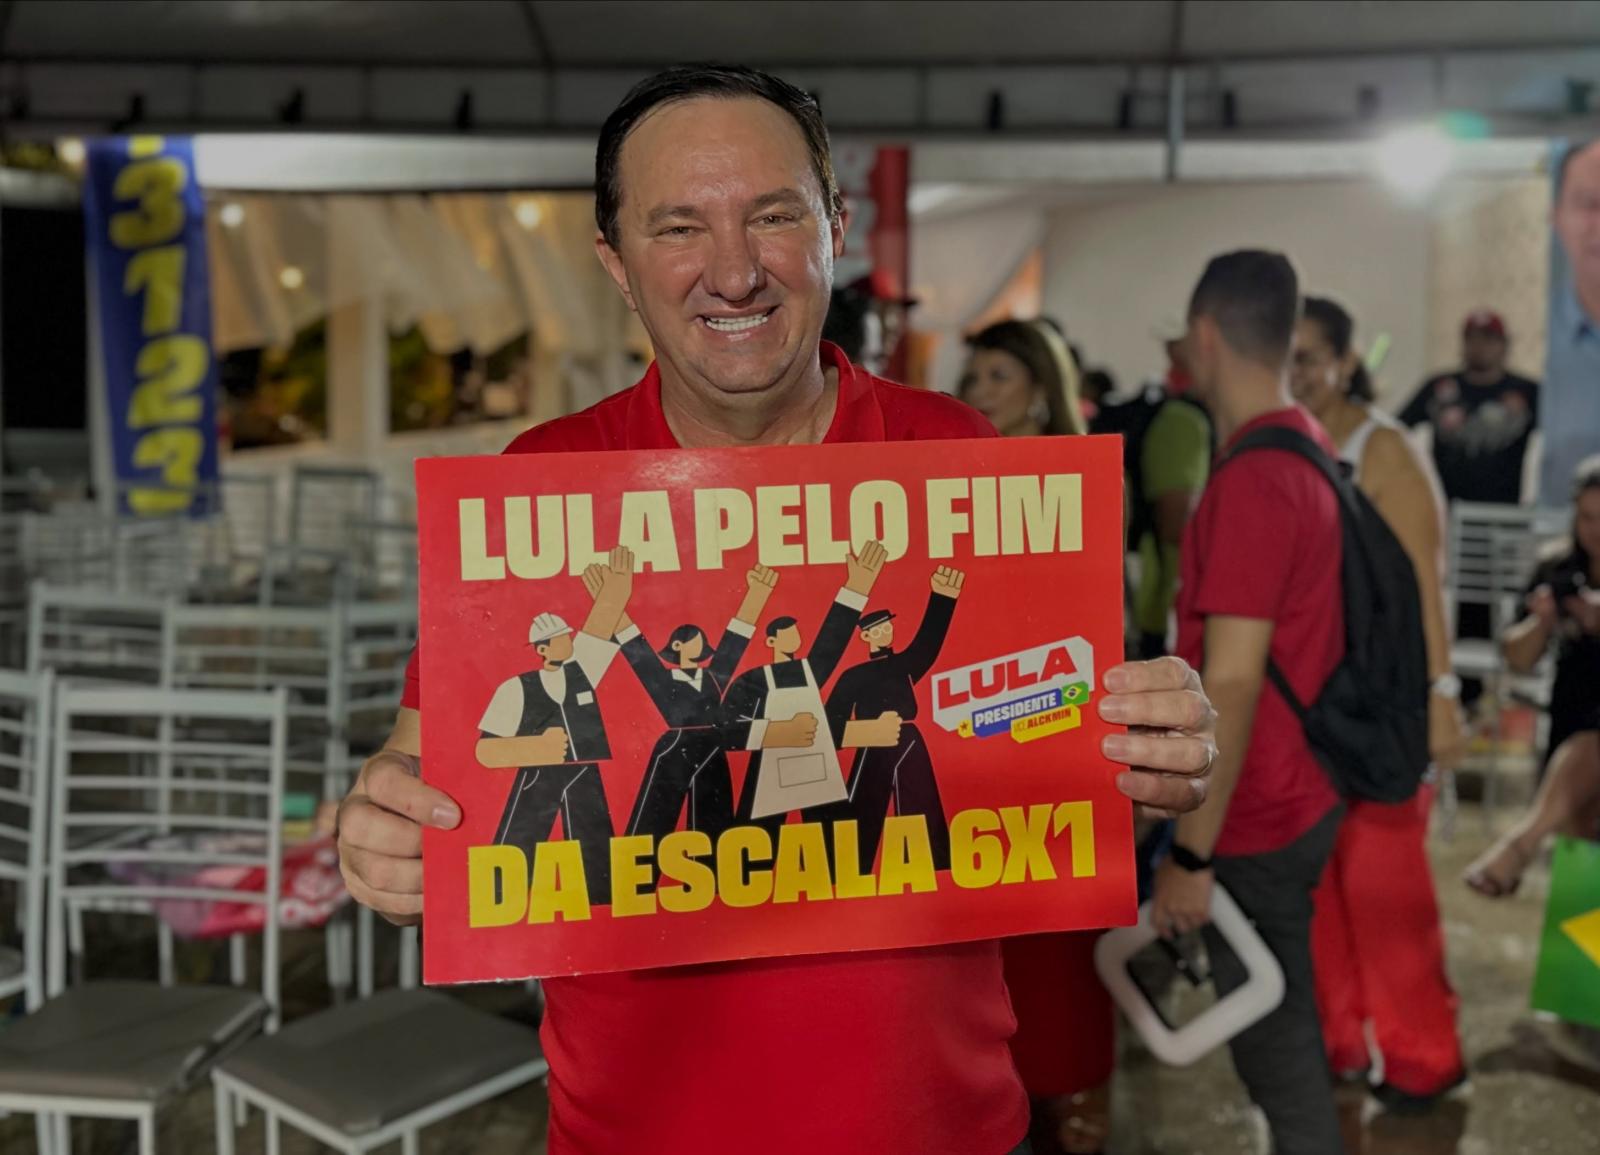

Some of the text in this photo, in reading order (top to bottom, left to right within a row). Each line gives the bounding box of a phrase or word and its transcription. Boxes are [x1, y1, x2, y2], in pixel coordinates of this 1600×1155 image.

[459, 473, 1082, 581] LULA PELO FIM
[938, 646, 1077, 709] LULA
[974, 693, 1056, 727] PRESIDENTE
[1027, 707, 1071, 729] ALCKMIN
[468, 800, 1096, 928] DA ESCALA 6X1
